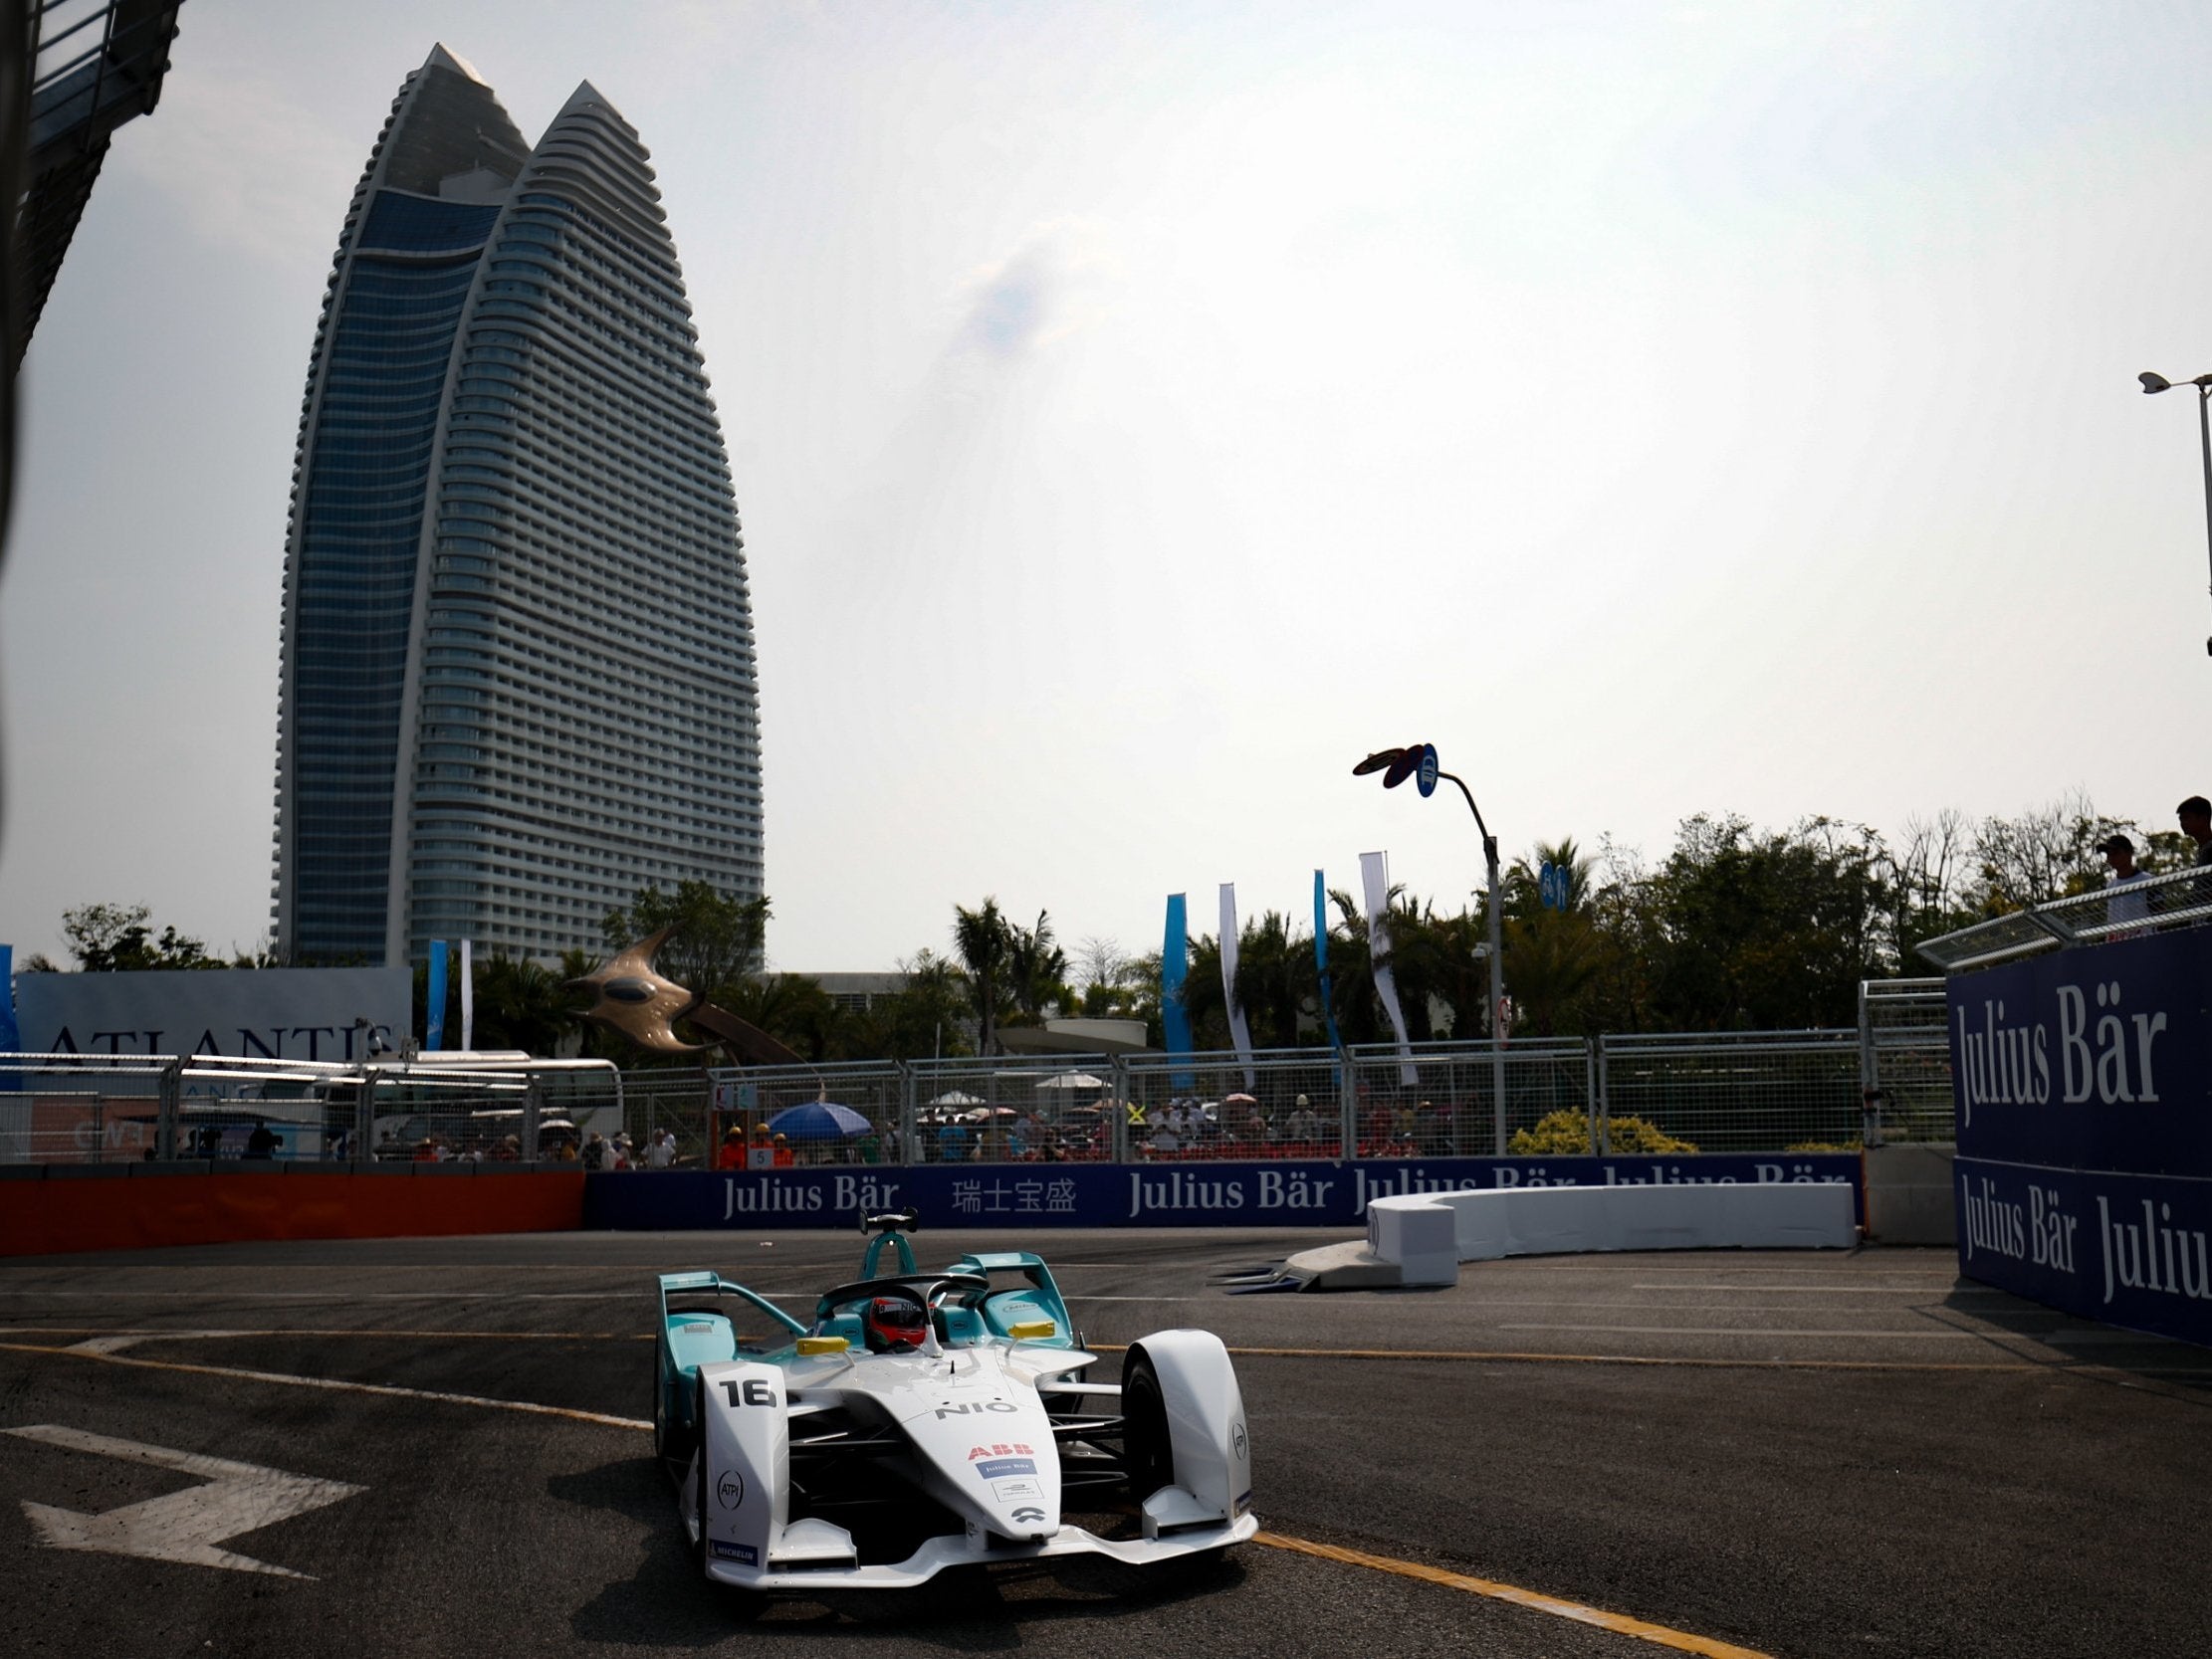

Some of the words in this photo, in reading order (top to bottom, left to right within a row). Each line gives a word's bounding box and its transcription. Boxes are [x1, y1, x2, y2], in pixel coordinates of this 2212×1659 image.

[1957, 1000, 2050, 1129] Julius
[2057, 981, 2167, 1105] Bär
[757, 1151, 766, 1165] 5
[724, 1177, 822, 1220] Julius
[833, 1175, 899, 1211] Bär
[952, 1178, 1076, 1213] 瑞士宝盛
[1129, 1168, 1243, 1218] Julius
[1257, 1170, 1334, 1208] Bär
[1963, 1174, 2025, 1261] Julius
[2029, 1184, 2077, 1274] Bär
[719, 1379, 776, 1408] 16
[935, 1402, 1018, 1420] NIO
[968, 1443, 1034, 1460] ABB
[718, 1546, 754, 1560] MICHELIN
